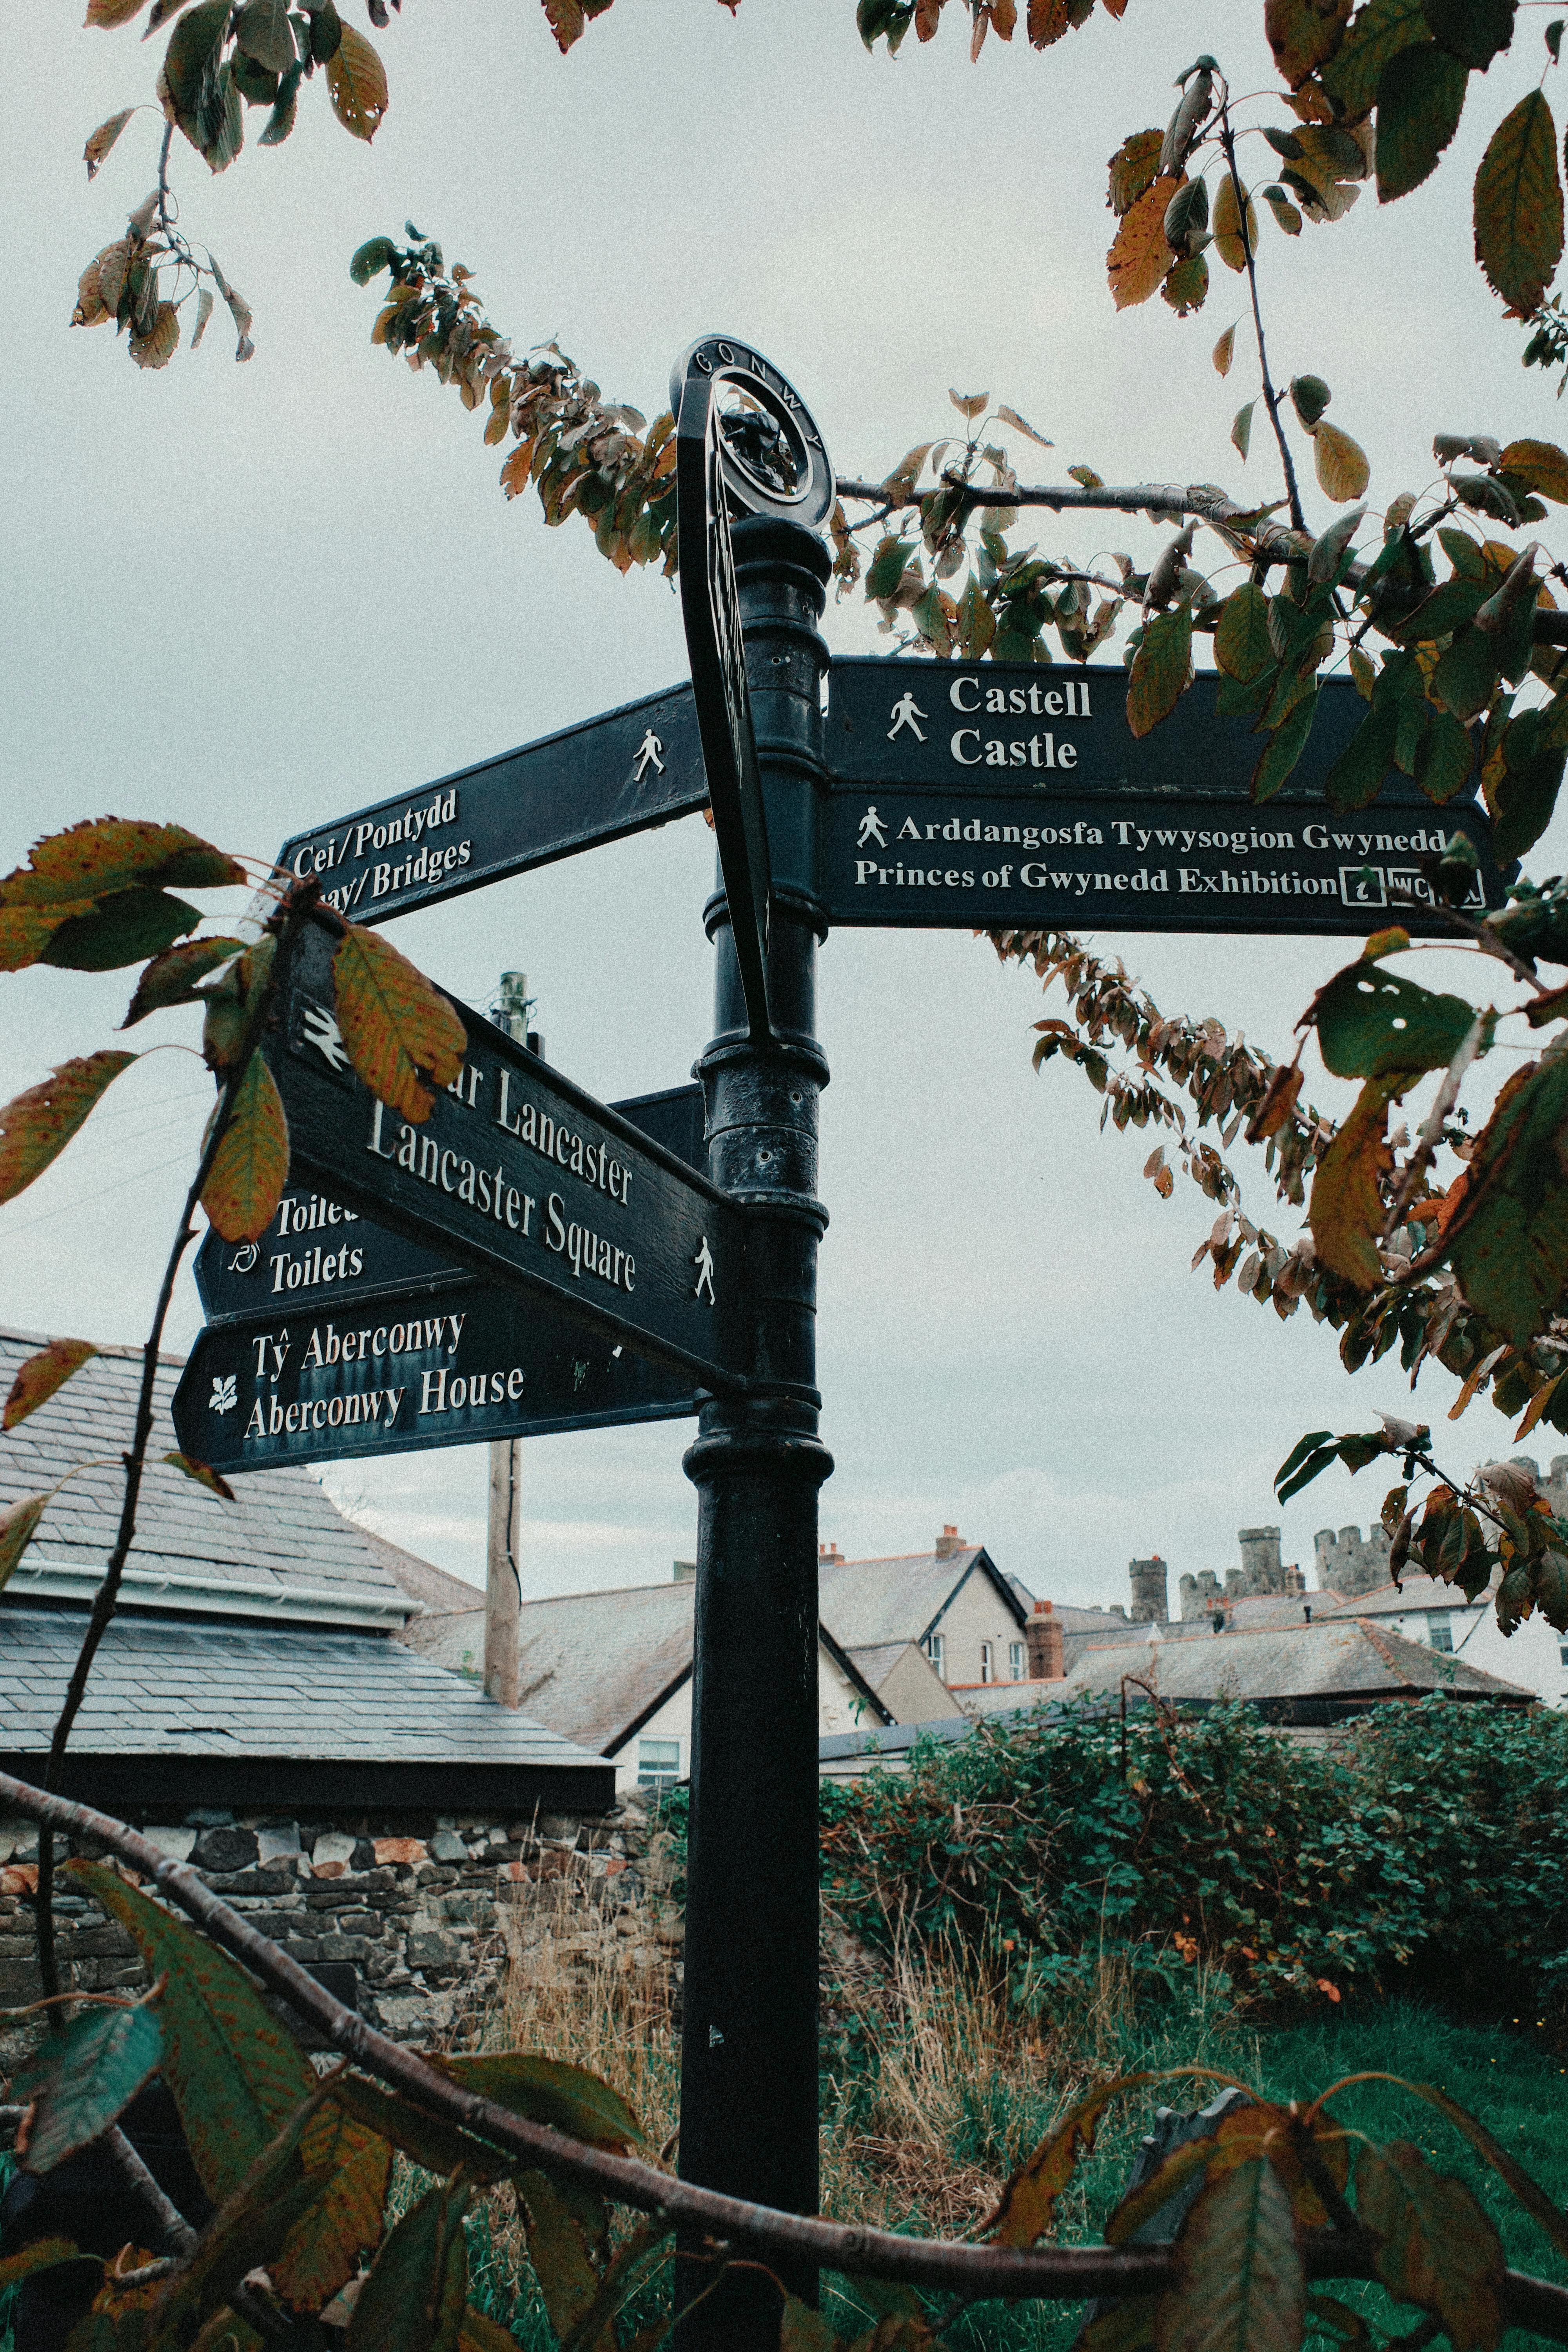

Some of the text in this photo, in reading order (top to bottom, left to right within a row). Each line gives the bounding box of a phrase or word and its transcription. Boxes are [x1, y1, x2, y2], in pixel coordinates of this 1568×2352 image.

[696, 343, 822, 449] CONWY
[950, 677, 1093, 716] Castell
[950, 729, 1077, 769] Castle
[294, 789, 457, 878] Cei/Pontydd
[896, 816, 1446, 856] Arddangosfa Tywysogion Gwynedd
[854, 861, 975, 887] Princes
[982, 865, 1014, 888] of
[1020, 863, 1169, 896] Gwynedd
[1178, 868, 1338, 895] Exhibition
[497, 1067, 633, 1205] Lancaster
[367, 1099, 635, 1290] Lancaster Square
[270, 1243, 363, 1293] Toilets
[301, 1313, 467, 1370] Aberconwy
[243, 1367, 525, 1439] Aberconwy House
